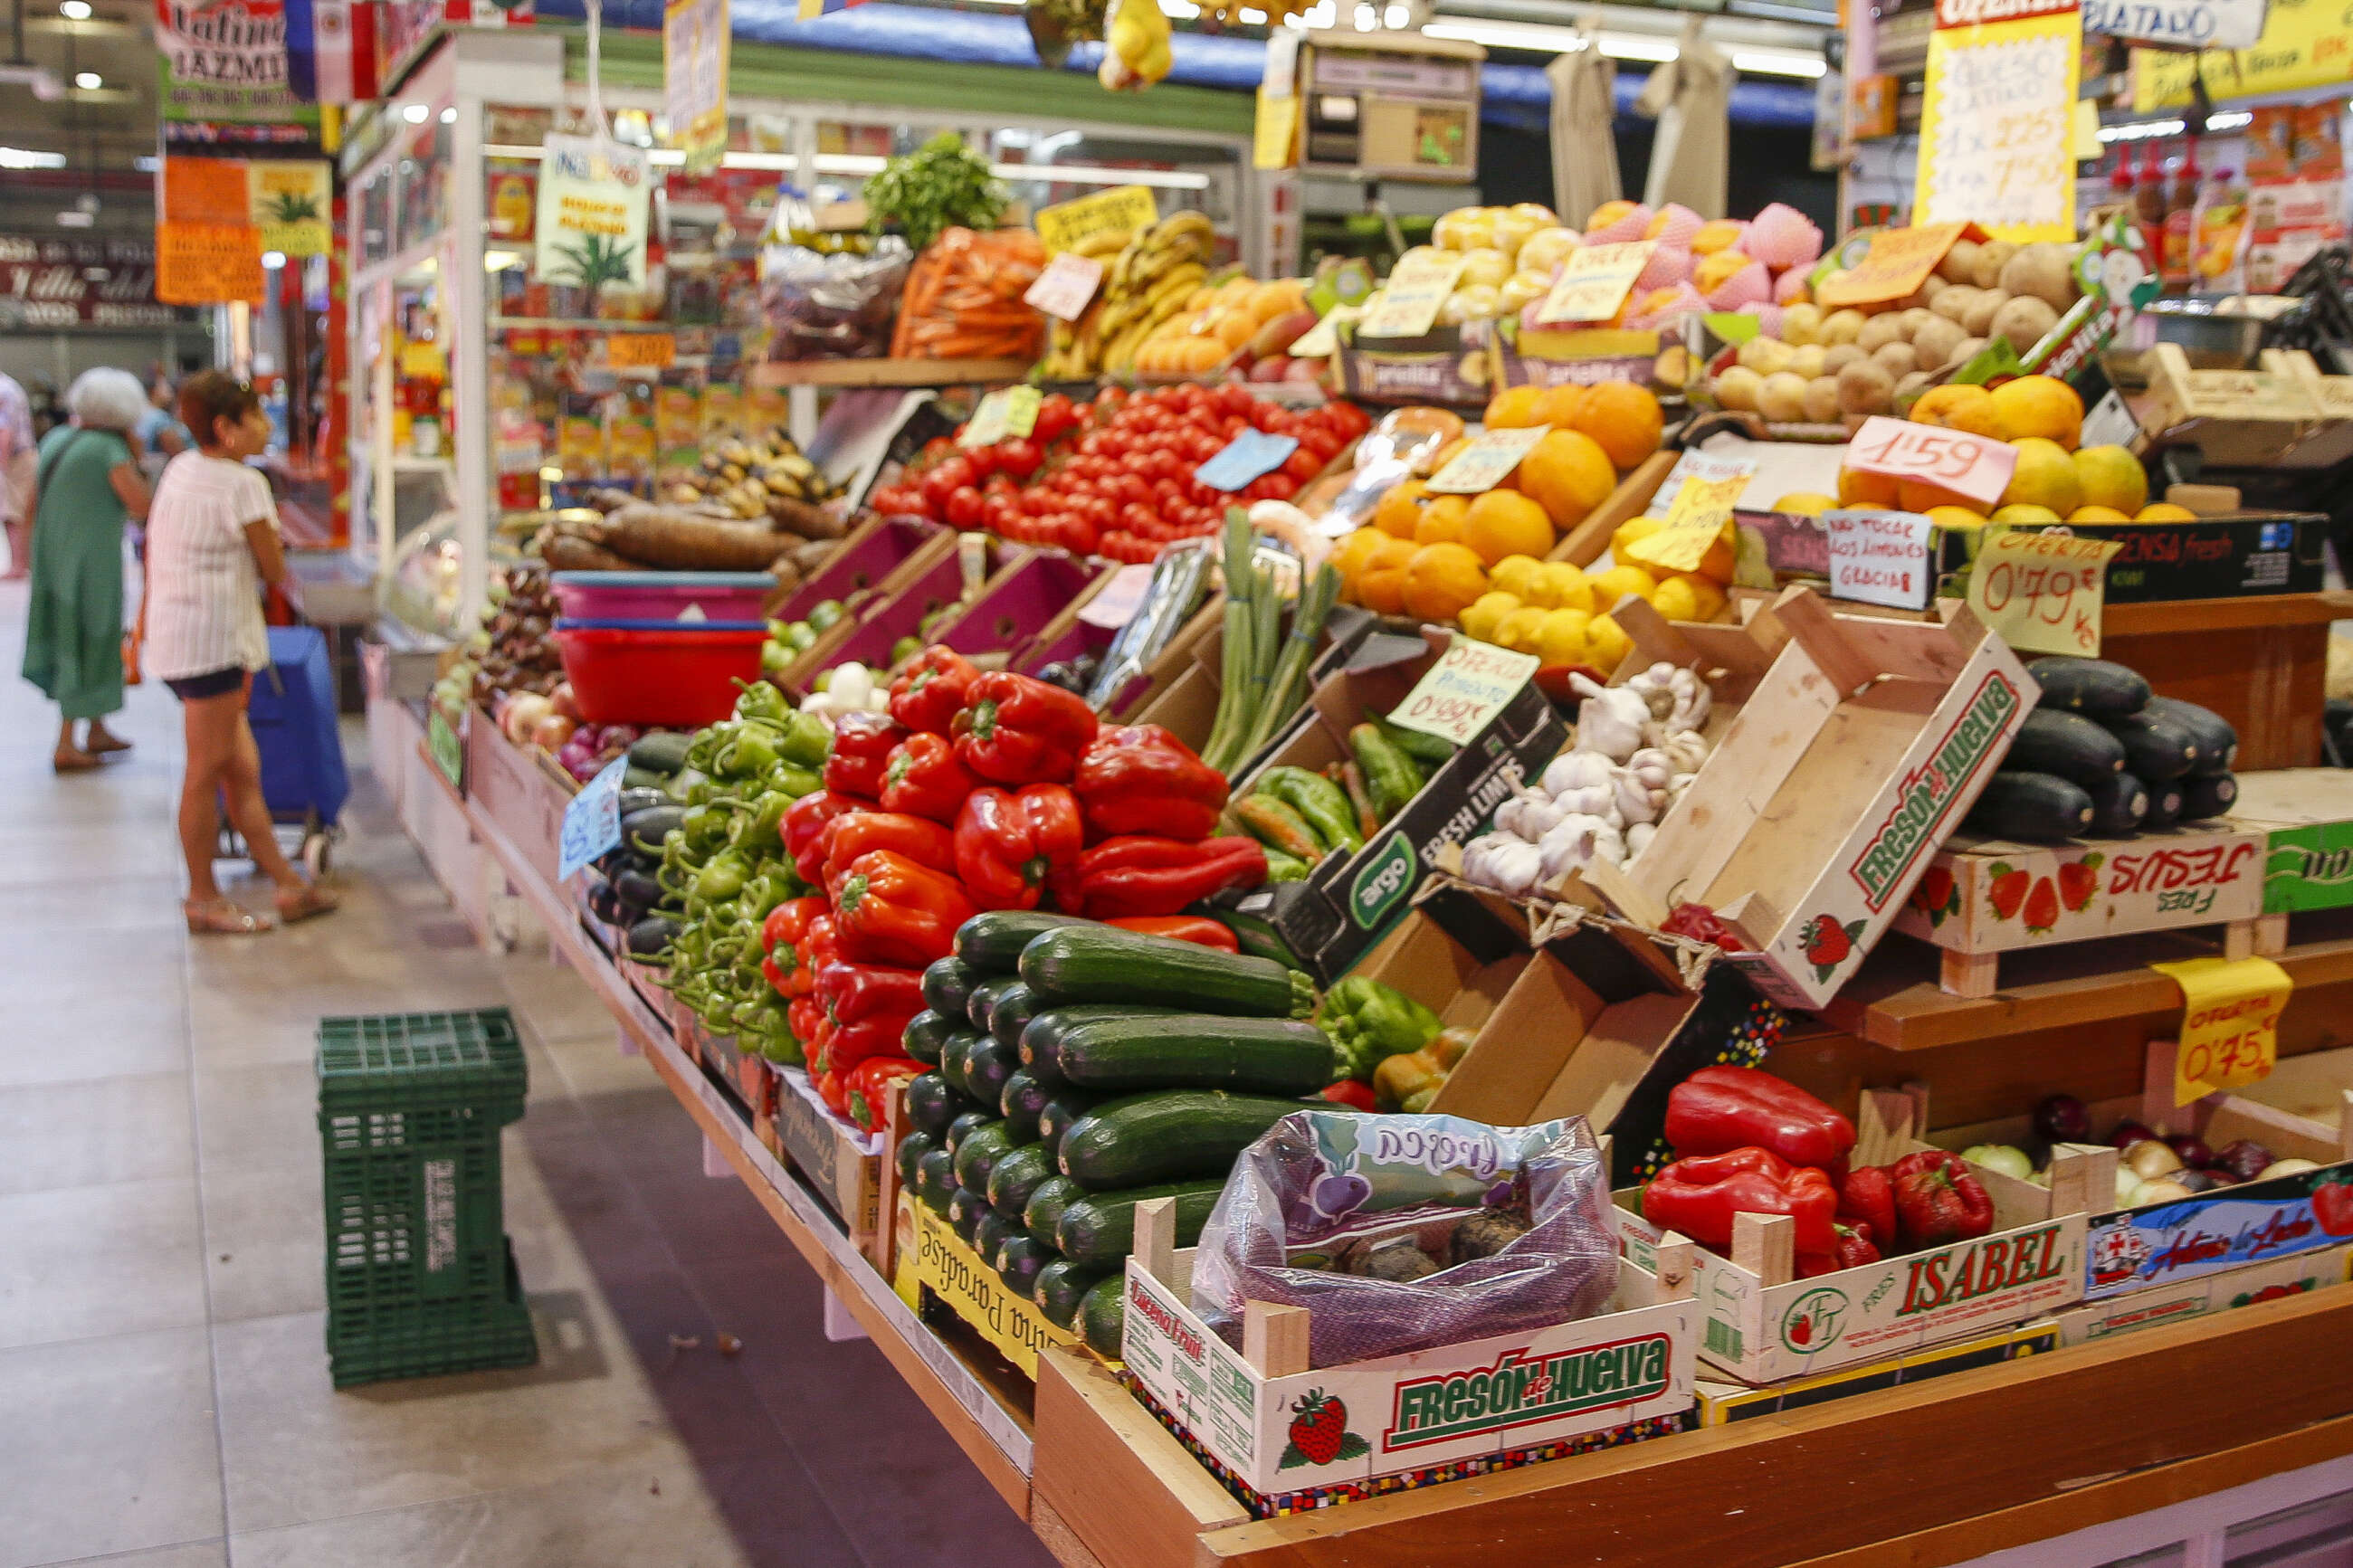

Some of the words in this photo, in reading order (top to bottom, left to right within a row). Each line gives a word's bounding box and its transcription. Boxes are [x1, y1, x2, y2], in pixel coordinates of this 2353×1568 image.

[1469, 756, 1527, 815] LIMS
[2109, 842, 2255, 895] JESUS
[921, 1230, 1005, 1336] Paradise
[1009, 1307, 1062, 1354] una
[1895, 1224, 2065, 1317] ISABEL
